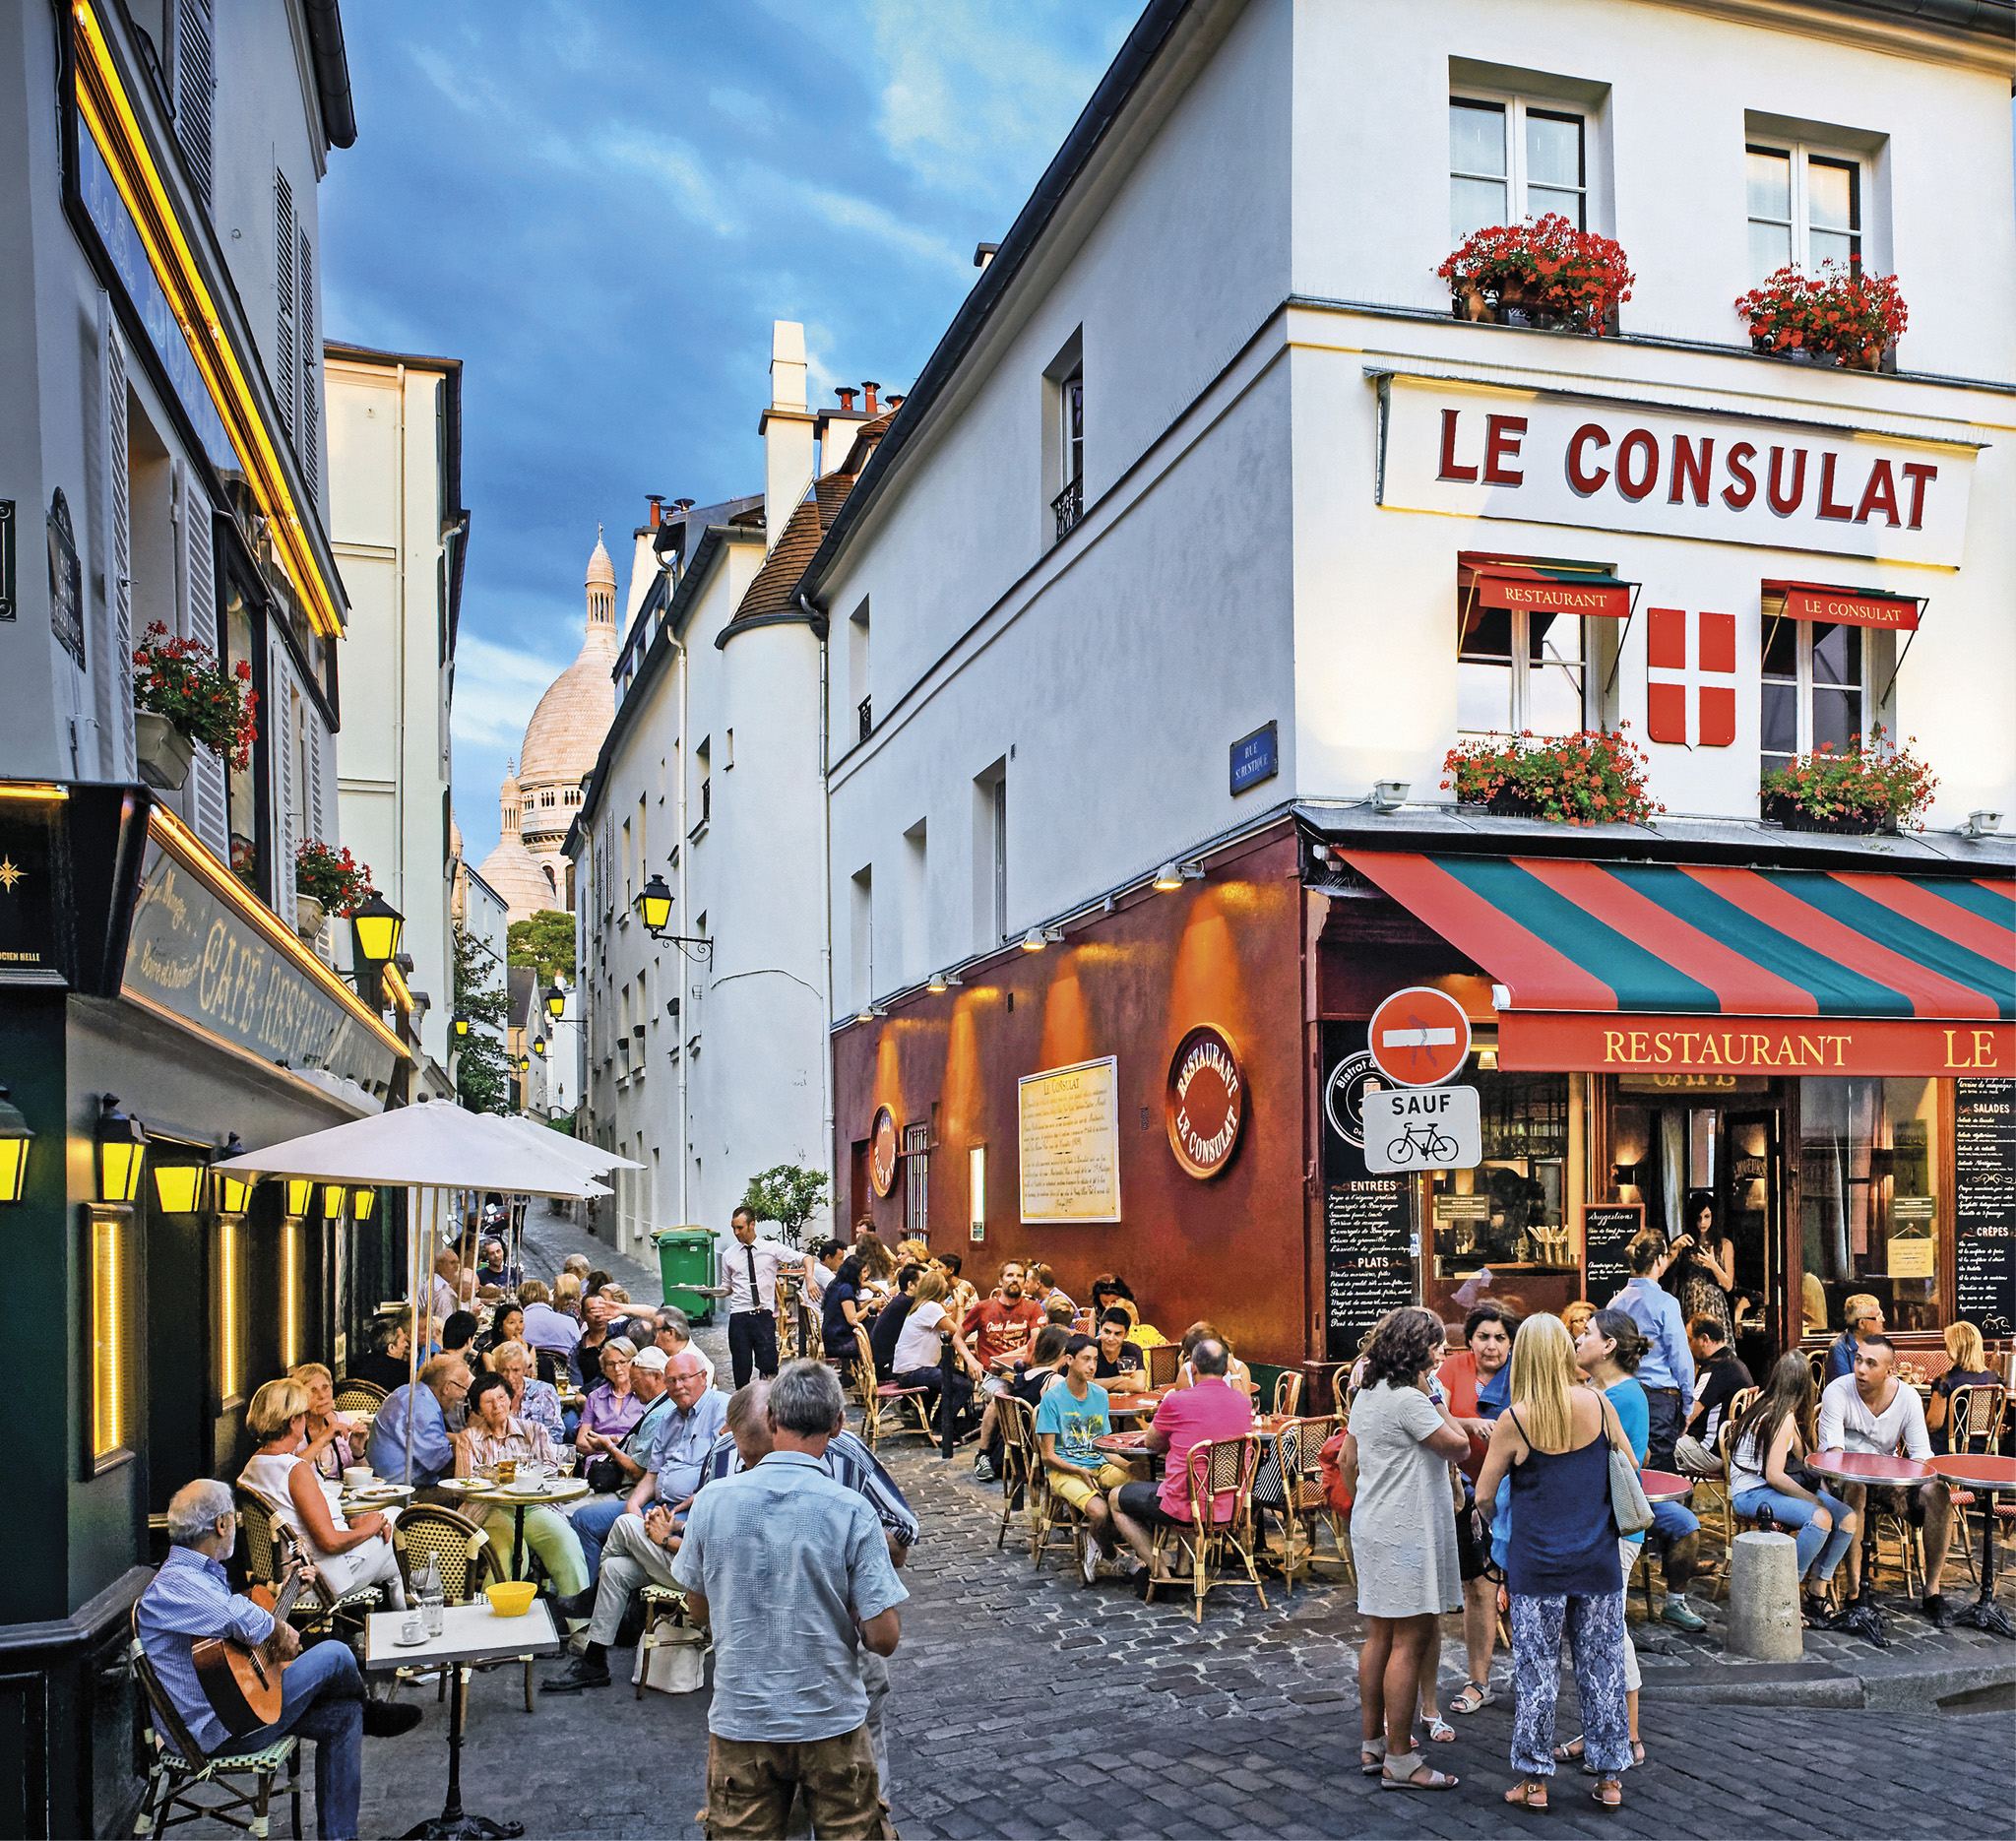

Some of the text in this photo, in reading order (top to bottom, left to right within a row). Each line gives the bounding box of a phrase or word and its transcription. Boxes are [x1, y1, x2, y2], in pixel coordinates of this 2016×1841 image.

[1435, 409, 1937, 530] LE CONSULAT
[1505, 587, 1606, 608] RESTAURANT
[1804, 599, 1902, 622] LE CONSULAT
[1604, 1030, 1998, 1068] RESTAURANT LE
[1177, 1043, 1239, 1101] RESTAURANT
[1336, 1059, 1367, 1089] Bistrot
[1391, 1094, 1451, 1115] SAUF
[1973, 1104, 2010, 1114] SALADES
[1177, 1106, 1191, 1141] LE
[1189, 1105, 1237, 1164] CONSULAT
[1351, 1180, 1397, 1191] ENTRÉES
[1588, 1212, 1633, 1225] Suggestions
[1977, 1226, 2009, 1237] CRÊPES
[1358, 1257, 1389, 1268] PLATS
